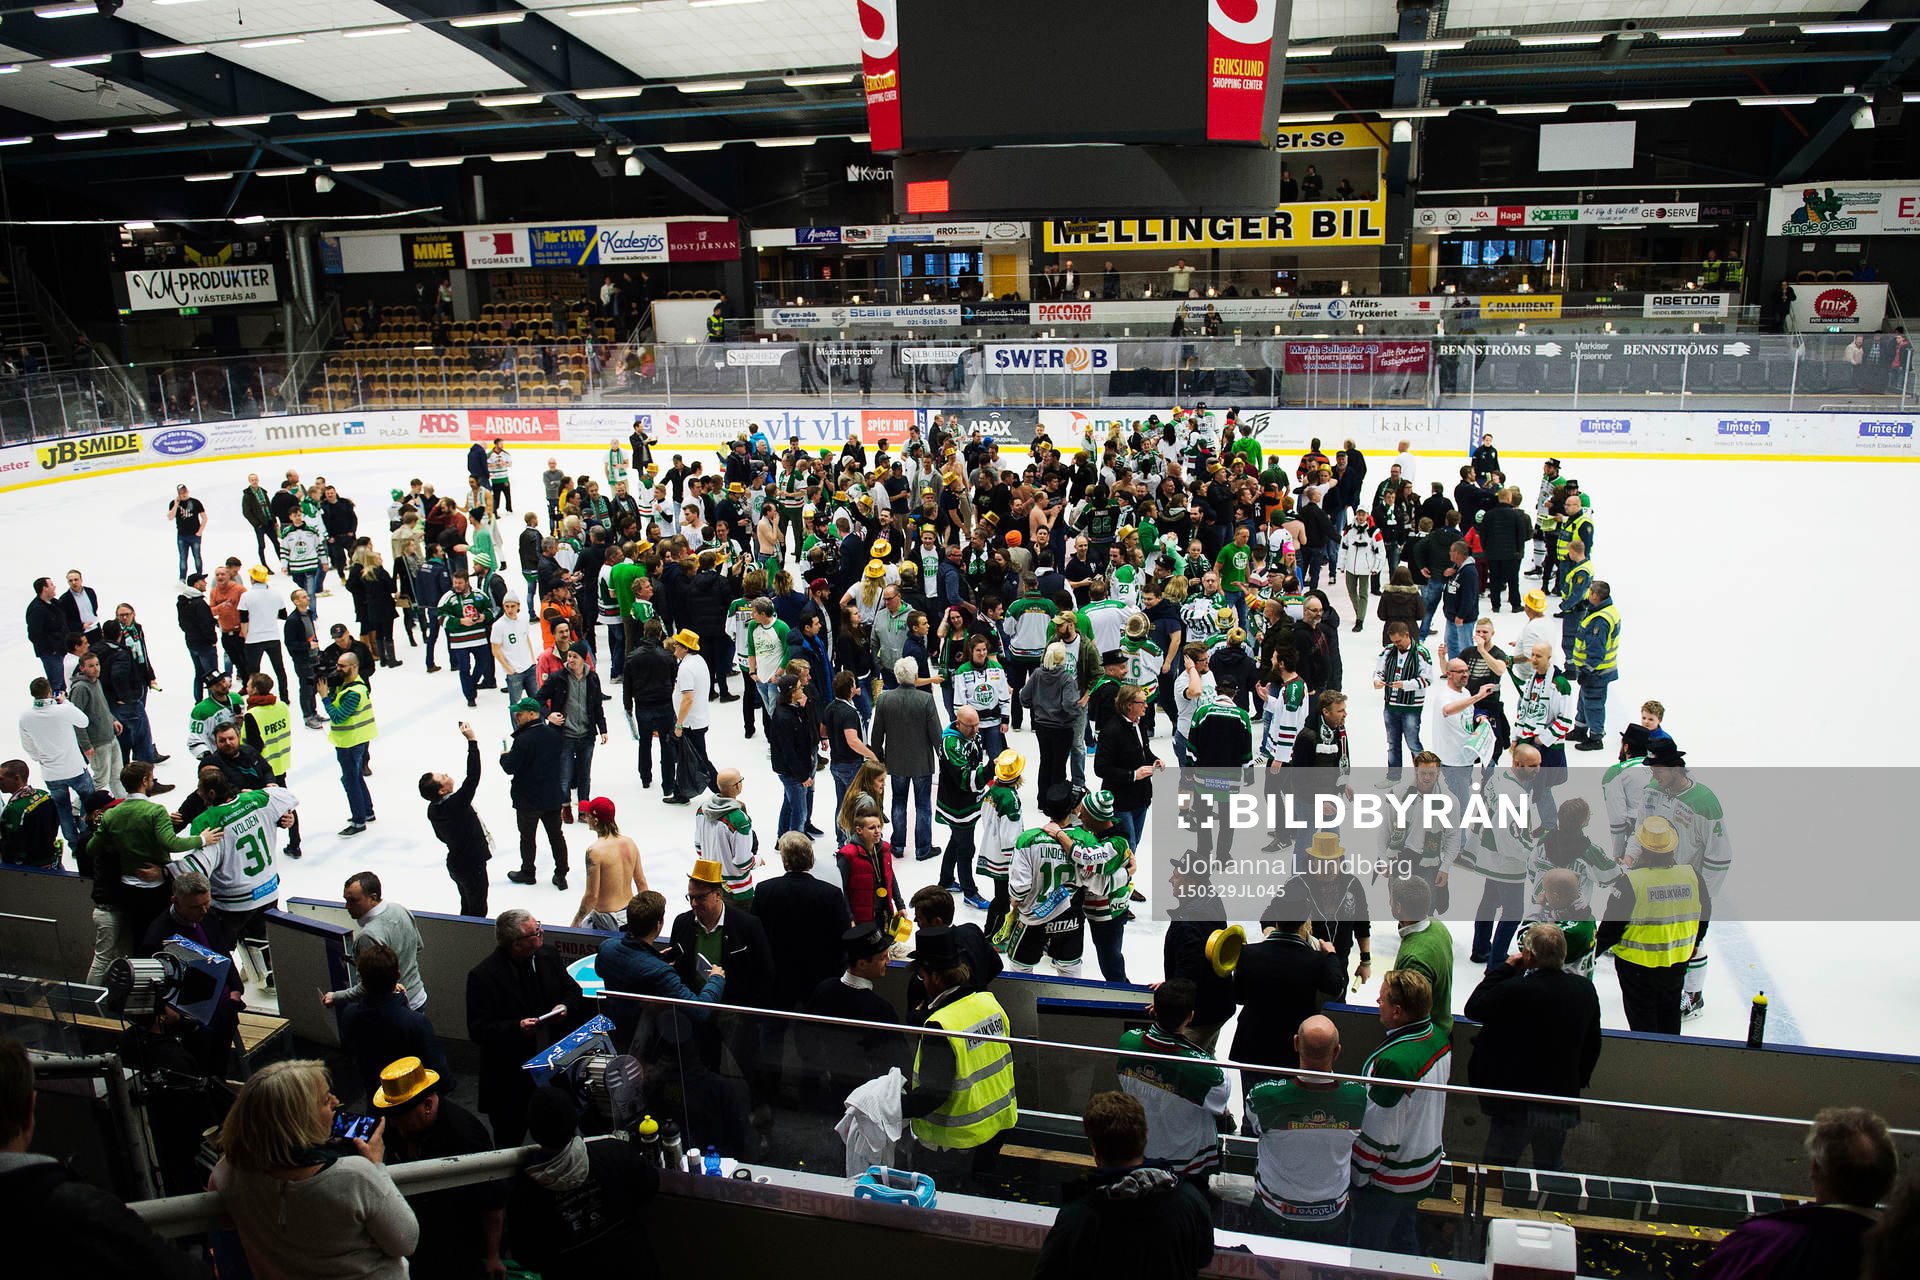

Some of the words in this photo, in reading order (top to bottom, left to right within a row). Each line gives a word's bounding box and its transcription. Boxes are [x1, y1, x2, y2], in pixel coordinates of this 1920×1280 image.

[1213, 57, 1264, 77] ERIKSLUND
[1212, 76, 1241, 89] SHOPPING
[1242, 78, 1264, 91] CENTER
[1500, 211, 1522, 220] Haga
[1052, 211, 1294, 244] MELLINGER
[1312, 209, 1381, 240] BIL
[1782, 222, 1819, 236] simple
[1819, 218, 1857, 236] green
[600, 230, 665, 254] Kadesjös
[413, 243, 454, 260] MME
[197, 293, 244, 303] VÄSTERÅS
[1349, 300, 1382, 308] Affärs-
[895, 307, 958, 318] eklundsglas.se
[1039, 304, 1091, 321] PACORA
[1298, 302, 1322, 310] Svensk
[1820, 299, 1851, 312] mix
[1349, 309, 1398, 319] Tryckeriet
[816, 347, 884, 358] Markentreprenör
[1440, 343, 1530, 356] BENNSTRÖMS
[1575, 342, 1609, 351] Markiser
[1623, 341, 1718, 355] BENNSTRÖMS
[863, 357, 873, 366] 80
[419, 414, 460, 433] AROS
[485, 416, 543, 434] ARBOGA
[684, 416, 751, 428] SJÖLANDERS
[764, 412, 808, 441] vlt
[812, 412, 855, 441] vlt
[868, 418, 891, 433] SPICY
[893, 419, 908, 431] HOT
[968, 421, 1012, 436] ABAX
[1588, 420, 1623, 431] Imtech
[1726, 422, 1761, 433] Imtech
[1867, 422, 1904, 435] Imtech
[379, 428, 411, 437] PLAZA
[686, 430, 733, 439] Mekaniska
[42, 441, 78, 470] JB
[79, 433, 137, 455] SMIDE
[1119, 584, 1130, 594] 23
[508, 633, 517, 645] 6
[190, 720, 204, 735] 40
[264, 718, 287, 736] PRESS
[232, 814, 259, 836] VOLDEN
[1712, 821, 1723, 838] 4
[235, 826, 273, 877] 31
[1650, 886, 1690, 900] PUBLIKVÄRD
[1045, 918, 1079, 933] RITTAL
